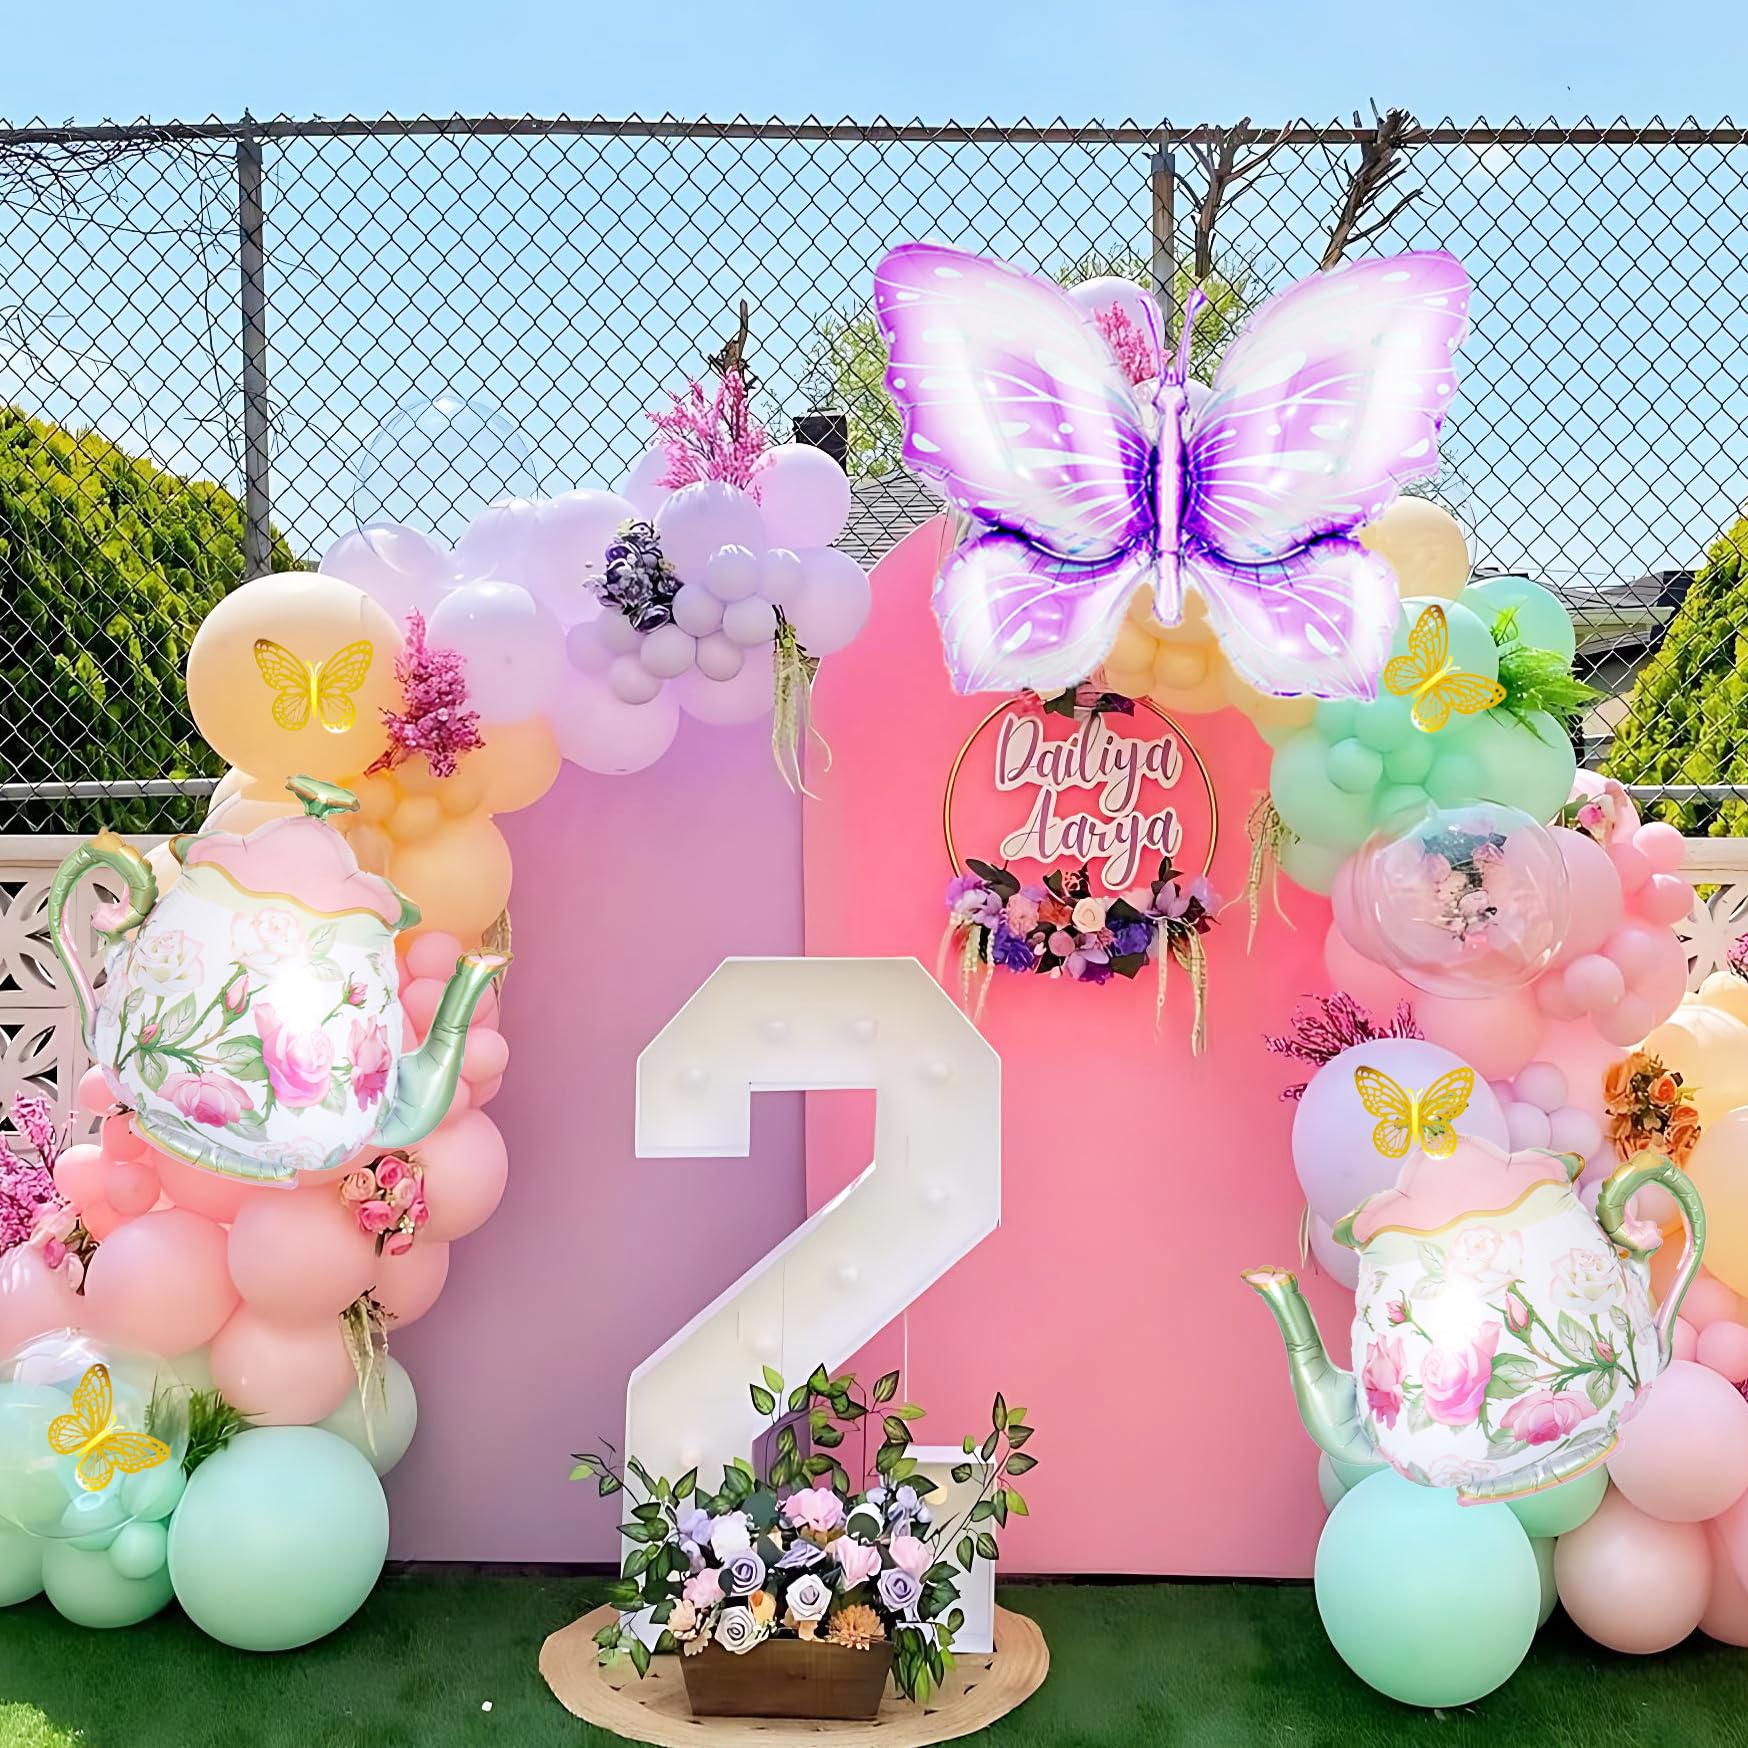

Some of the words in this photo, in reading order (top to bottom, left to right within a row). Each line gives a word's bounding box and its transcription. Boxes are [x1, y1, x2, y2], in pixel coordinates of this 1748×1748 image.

[997, 712, 1181, 815] Dailiya
[1001, 787, 1181, 888] Aarya
[621, 956, 1002, 1654] 2
